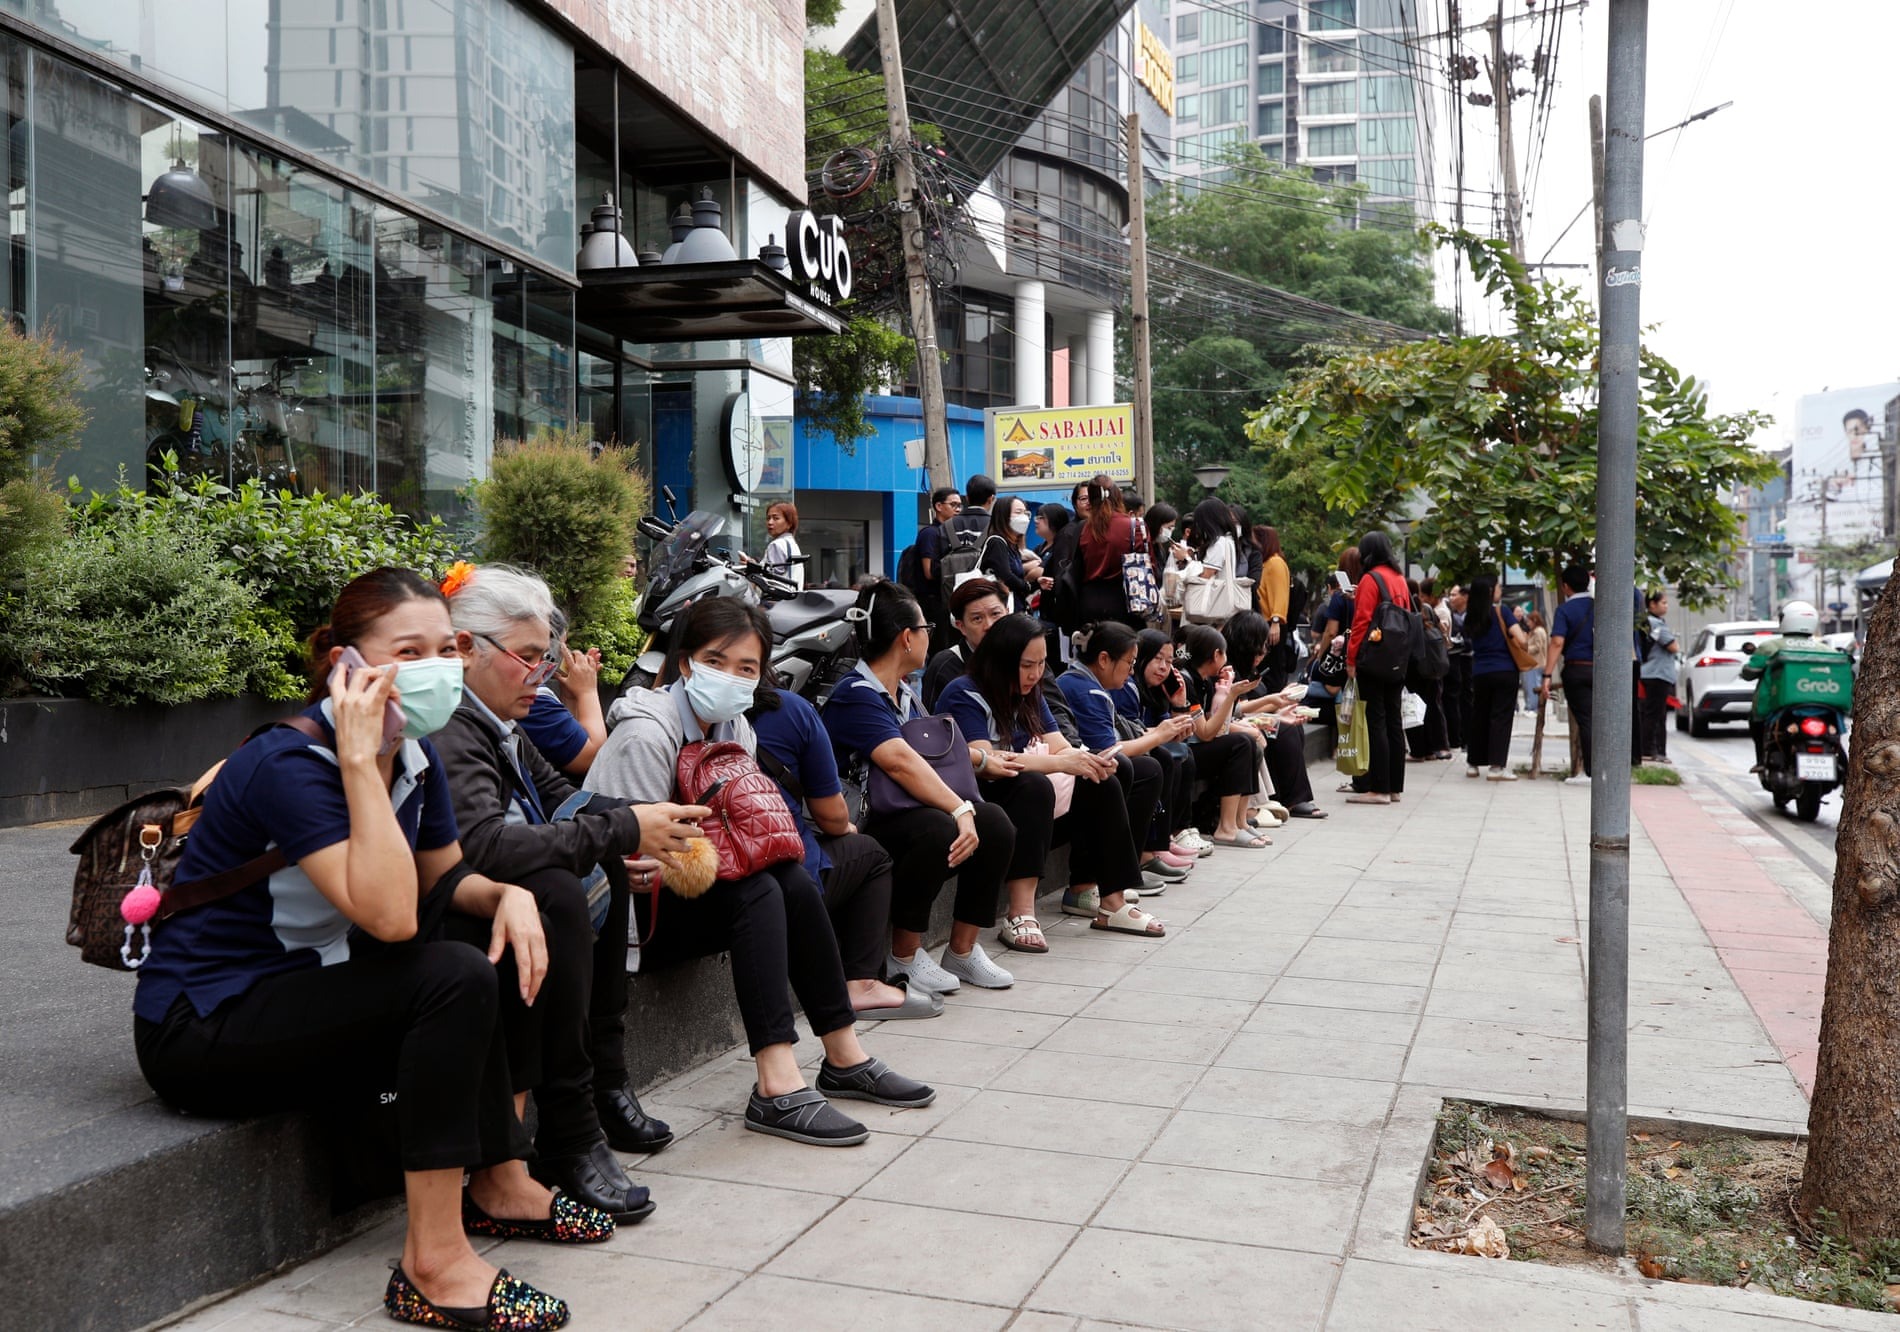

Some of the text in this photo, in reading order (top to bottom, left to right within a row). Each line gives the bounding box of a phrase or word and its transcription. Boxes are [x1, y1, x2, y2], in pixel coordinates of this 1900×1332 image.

[810, 281, 832, 307] HOUSE
[1039, 416, 1125, 440] SABAIJAI
[1060, 441, 1125, 451] RESTAURANT
[1087, 451, 1122, 465] สบายใจ
[1786, 639, 1816, 648] Grab
[1796, 678, 1840, 694] Grab
